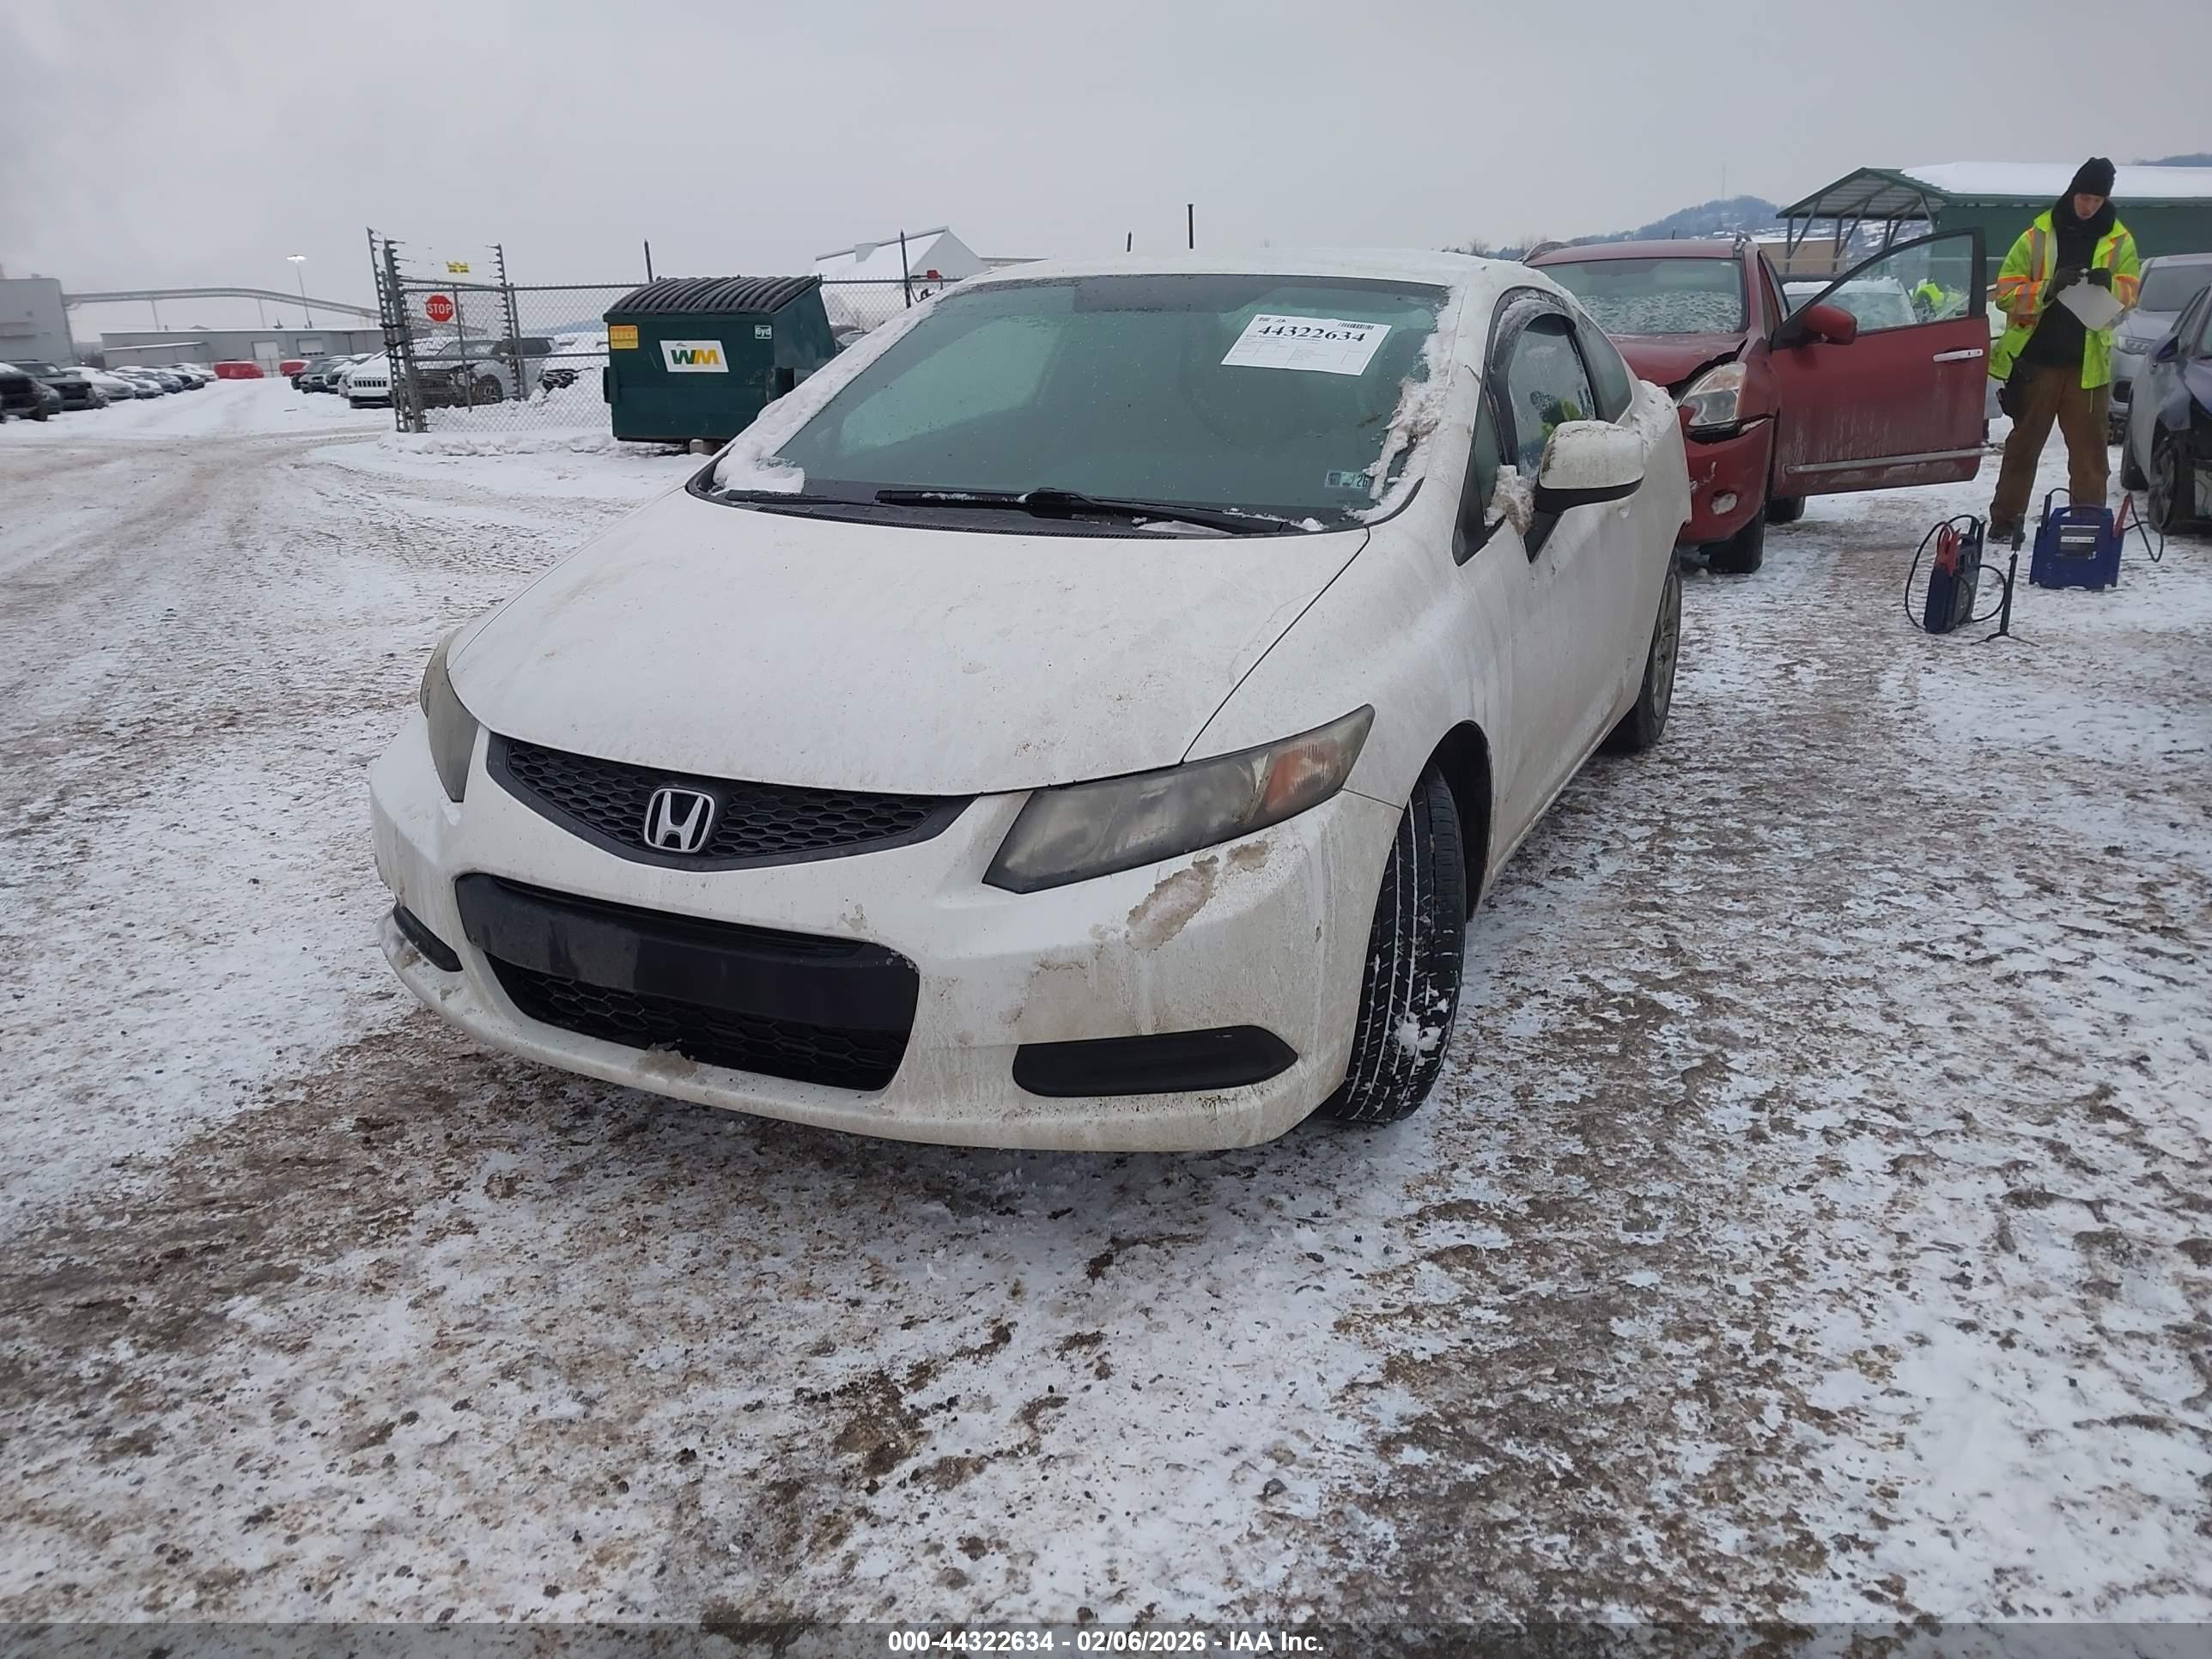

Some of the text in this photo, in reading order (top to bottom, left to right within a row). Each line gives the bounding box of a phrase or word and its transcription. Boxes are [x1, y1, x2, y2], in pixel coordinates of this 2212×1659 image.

[427, 303, 452, 315] STOP
[1257, 325, 1366, 342] 44322634
[671, 349, 720, 365] WM
